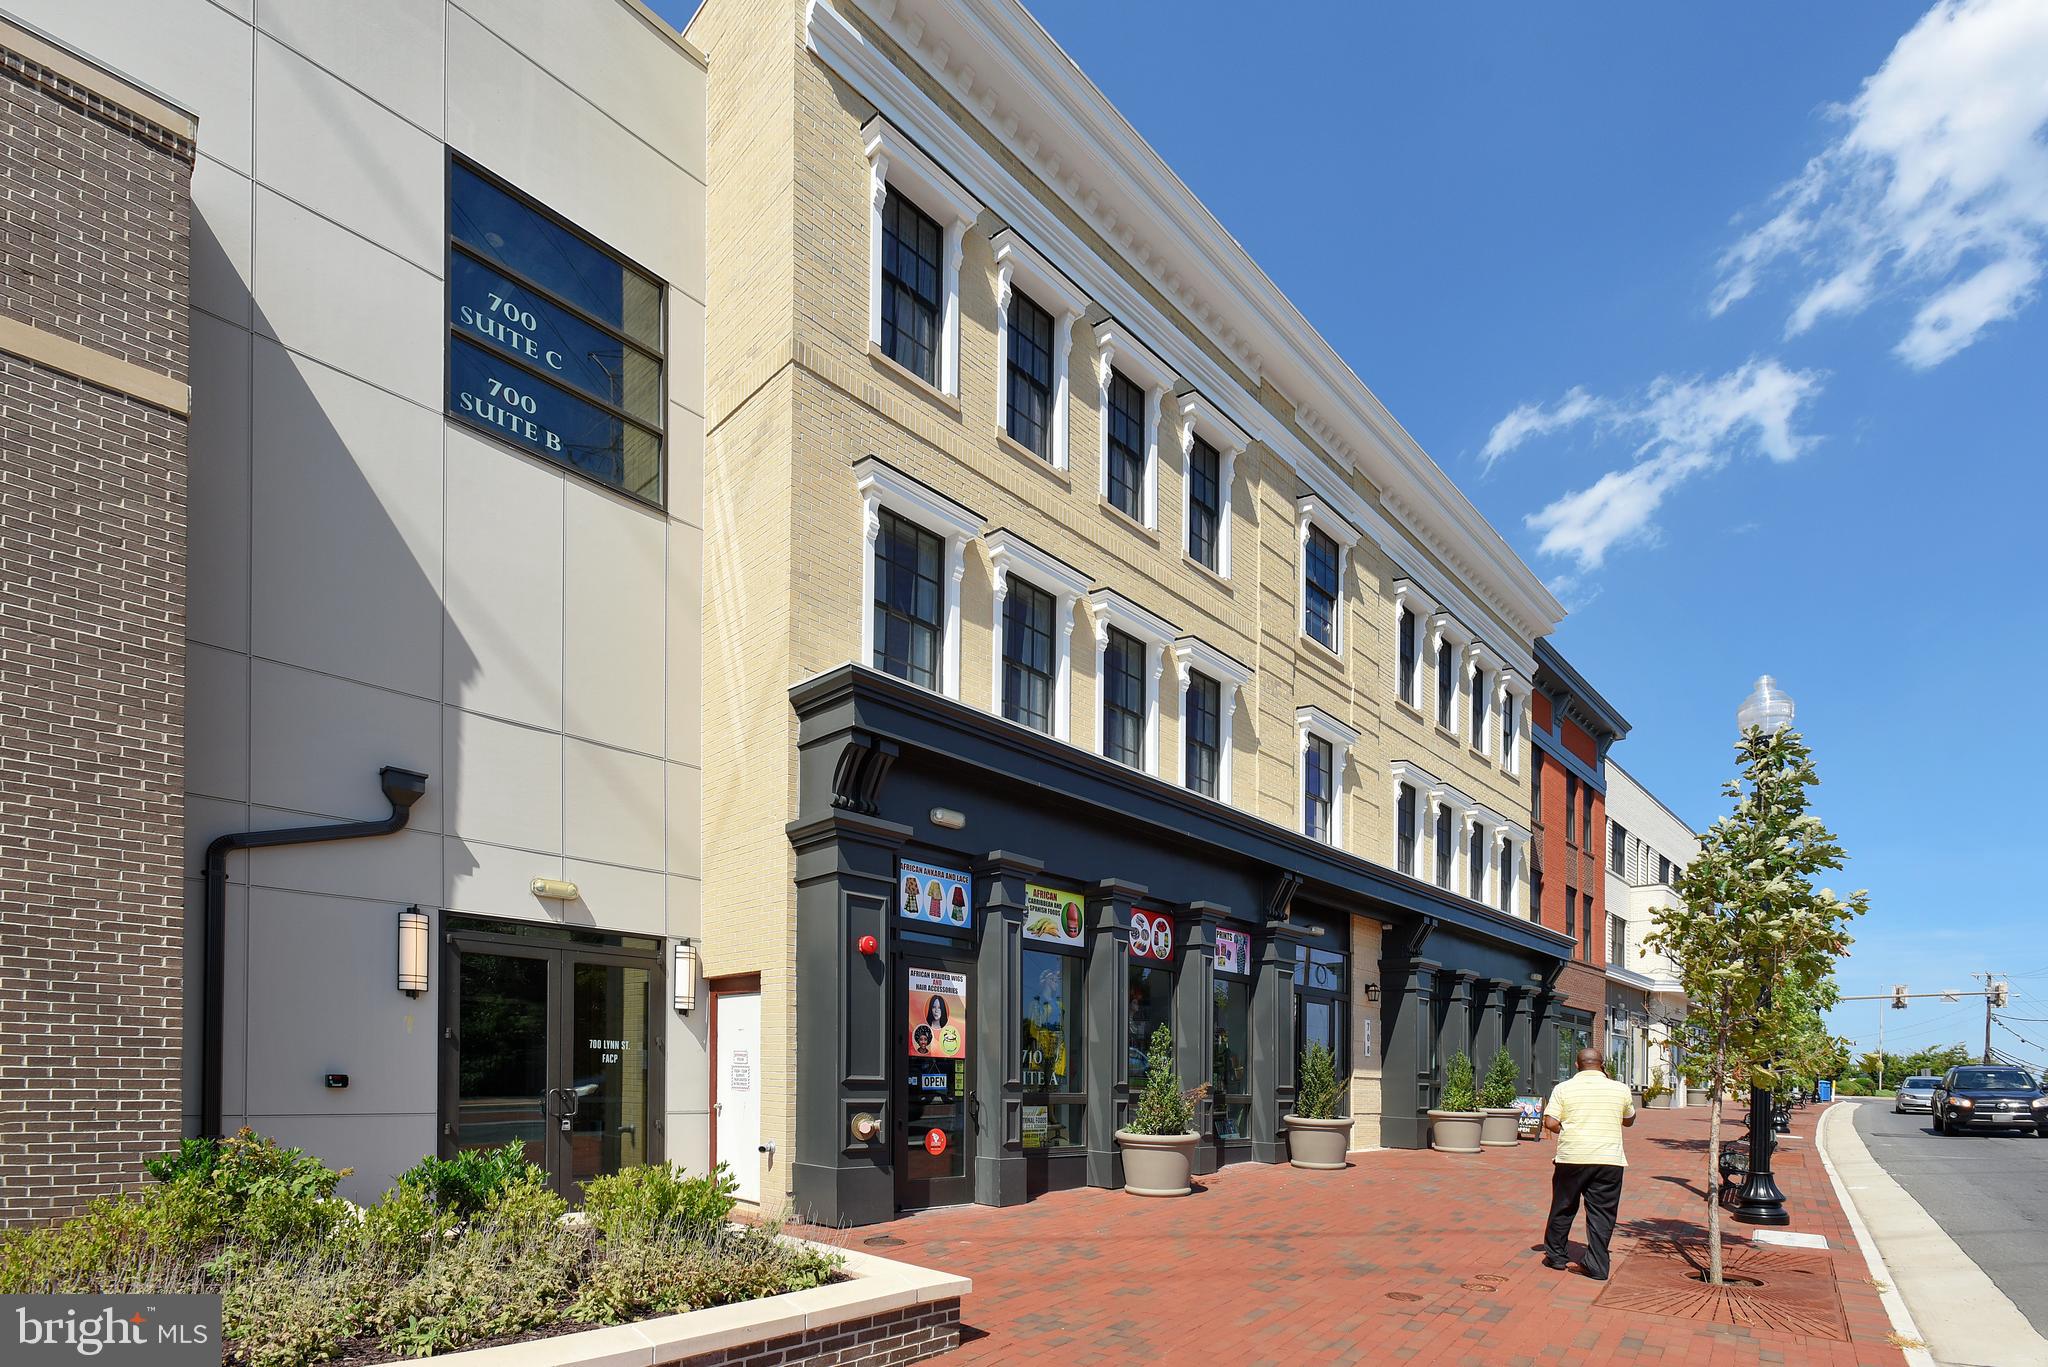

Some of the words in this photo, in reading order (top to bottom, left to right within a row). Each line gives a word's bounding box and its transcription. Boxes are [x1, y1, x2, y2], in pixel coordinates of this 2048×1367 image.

[488, 292, 537, 331] 700
[460, 305, 538, 359] SUITE
[545, 350, 562, 370] C
[488, 377, 537, 414] 700
[460, 392, 538, 442] SUITE
[545, 430, 561, 451] B
[900, 862, 923, 874] AFRICAN
[924, 867, 944, 879] ANKARA
[945, 872, 956, 881] AND
[956, 874, 969, 884] LACE
[1032, 888, 1058, 901] AFRICAN
[910, 969, 930, 978] AFRICAN
[930, 972, 951, 981] BRAIDED
[951, 975, 963, 983] WIGS
[927, 984, 958, 994] ACCESSORIES
[589, 1039, 602, 1049] 700
[603, 1039, 620, 1050] LYNN
[621, 1040, 630, 1050] ST.
[602, 1053, 618, 1063] FACP
[924, 1076, 945, 1087] OPEN
[1022, 1071, 1045, 1086] ITE
[1049, 1071, 1059, 1086] A
